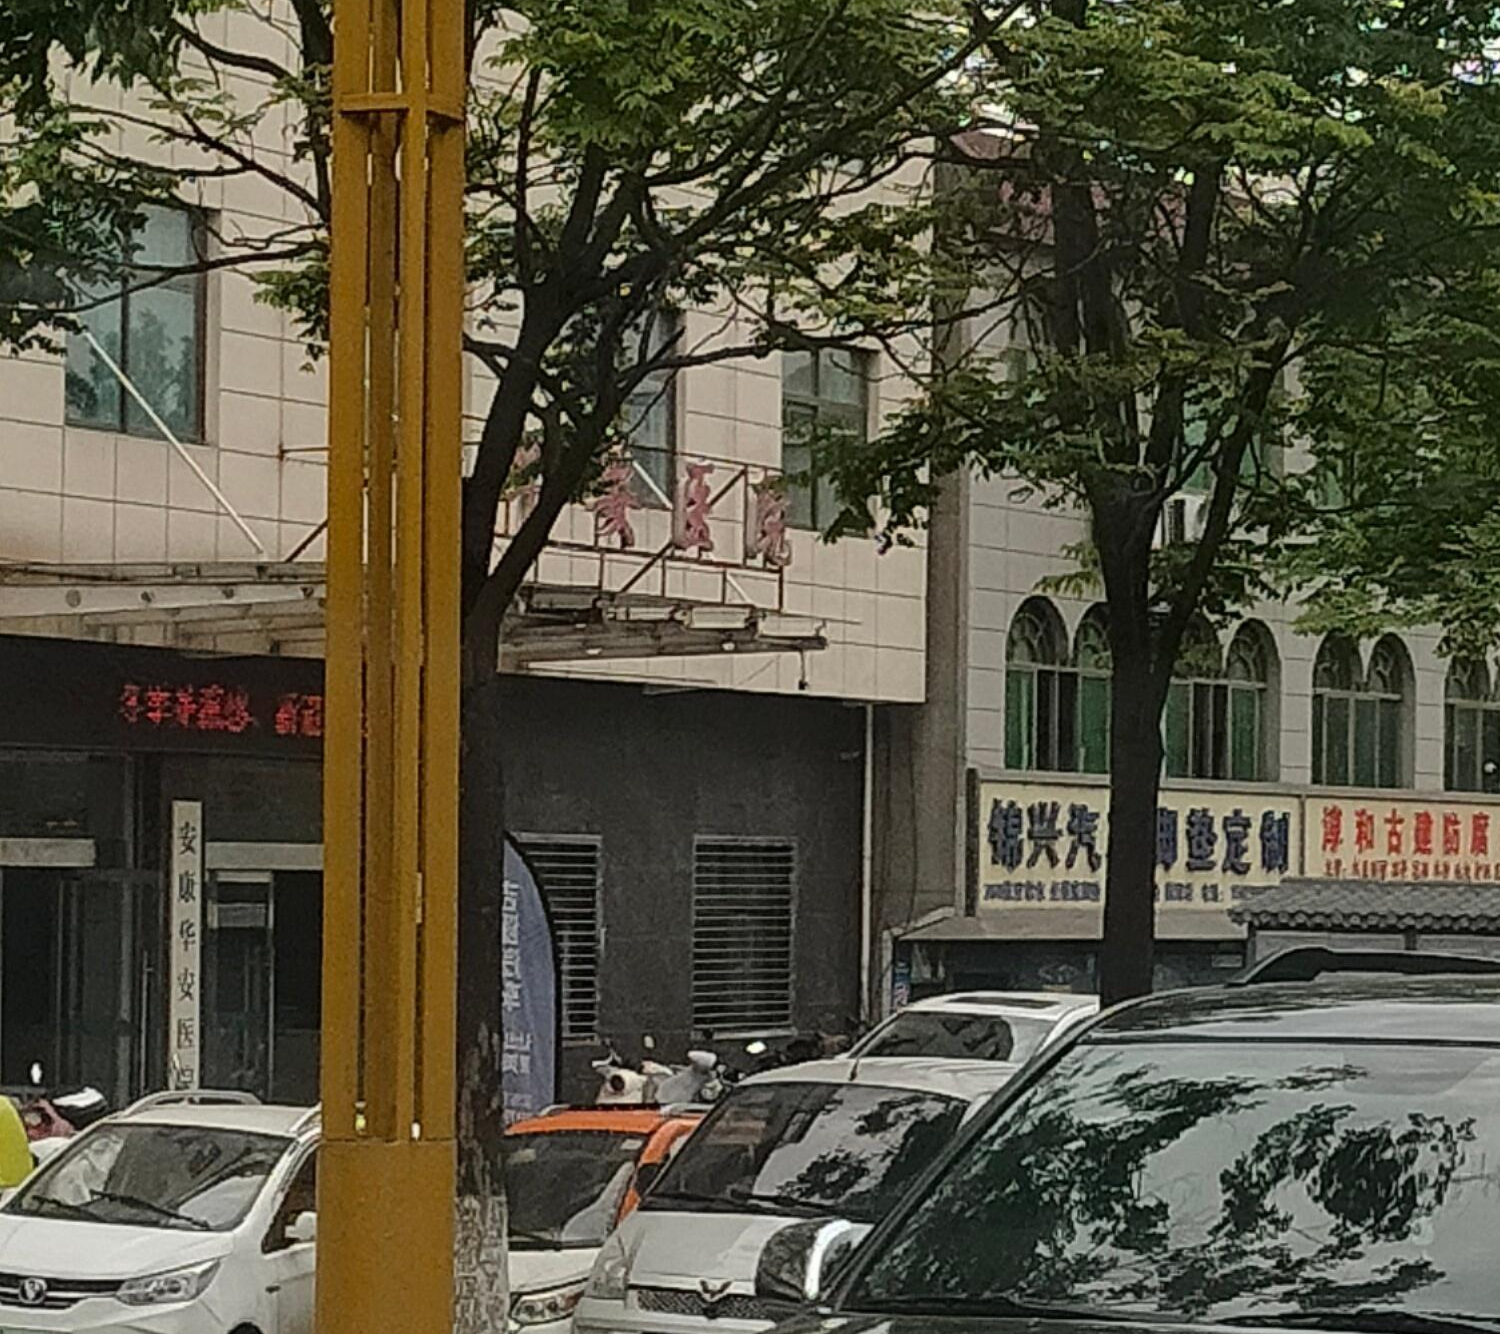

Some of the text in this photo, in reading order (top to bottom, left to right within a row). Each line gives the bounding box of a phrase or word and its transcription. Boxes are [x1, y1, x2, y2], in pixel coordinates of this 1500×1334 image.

[987, 798, 1291, 874] 锦兴汽脚垫定制
